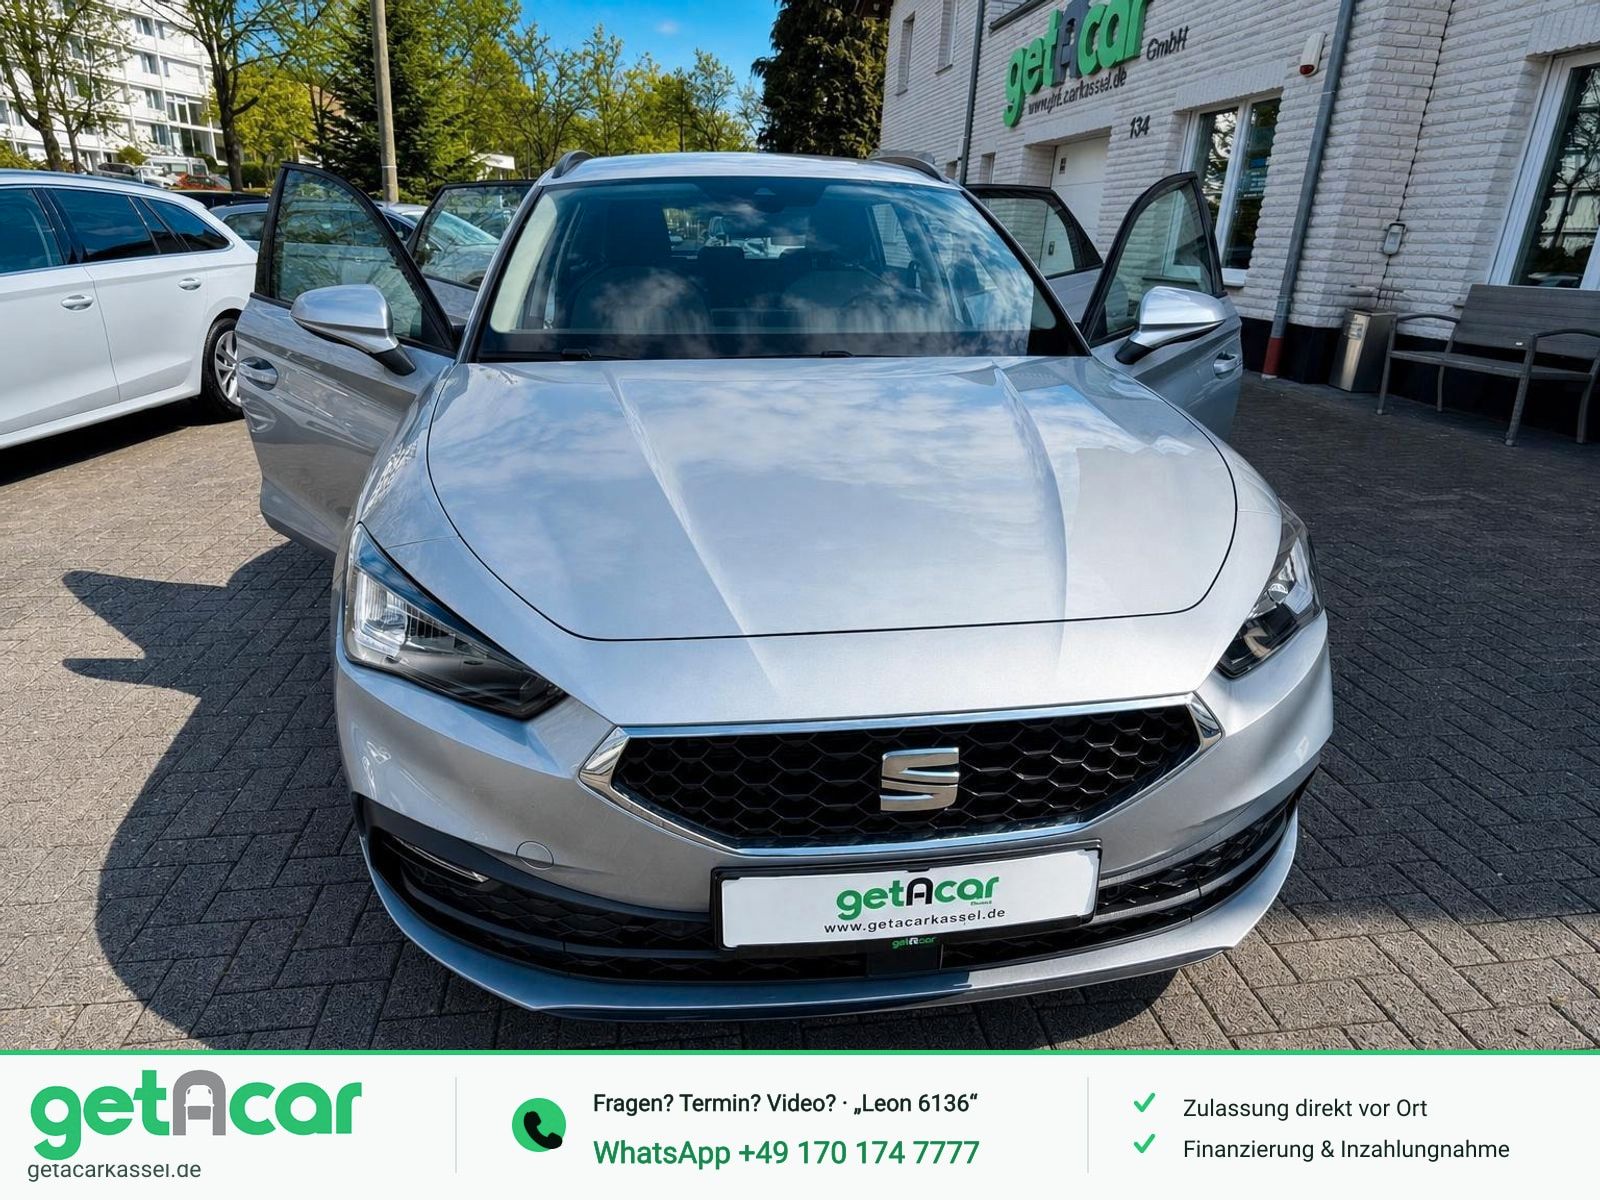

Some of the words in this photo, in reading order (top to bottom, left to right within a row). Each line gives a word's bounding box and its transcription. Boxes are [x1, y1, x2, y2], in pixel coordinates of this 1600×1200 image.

[1003, 0, 1149, 127] getAcar
[1146, 26, 1189, 61] GmbH
[1129, 115, 1151, 139] 134
[836, 875, 999, 921] getAcar
[823, 907, 1006, 934] www.getacarkassel.de
